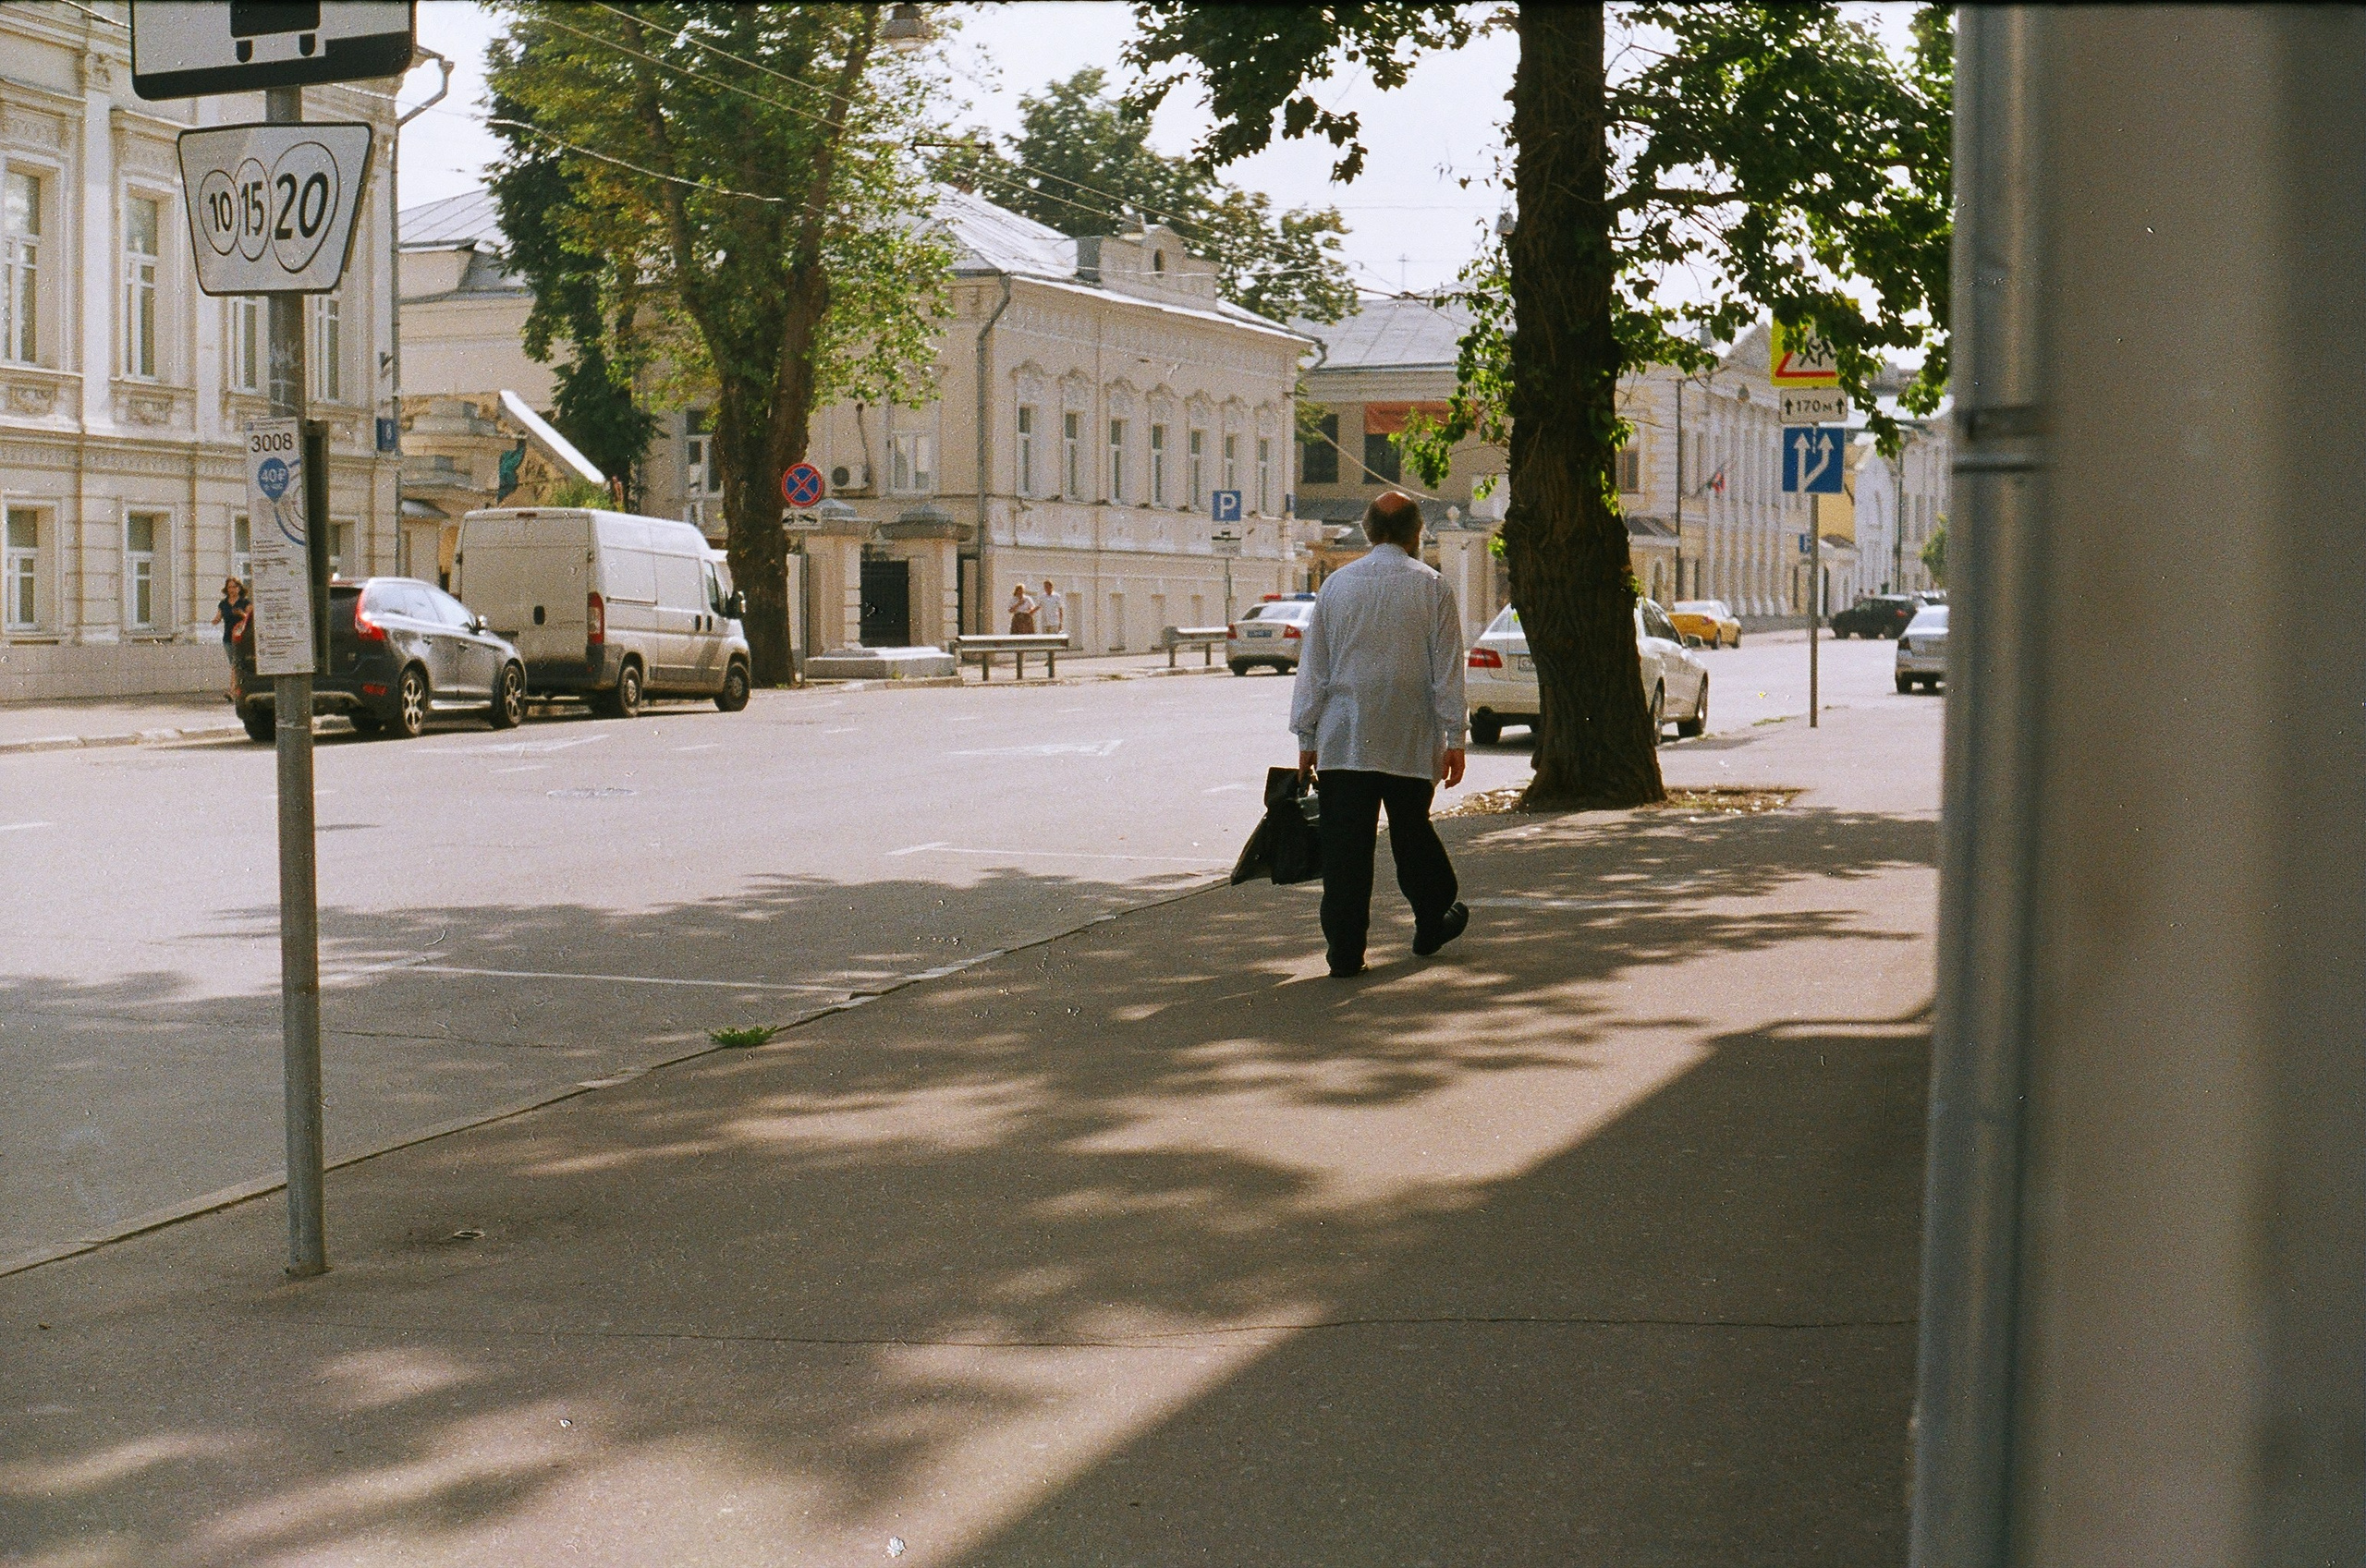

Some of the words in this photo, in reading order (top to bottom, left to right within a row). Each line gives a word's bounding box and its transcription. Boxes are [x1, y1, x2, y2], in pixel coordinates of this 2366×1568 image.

[209, 190, 233, 232] 10
[241, 181, 264, 237] 15
[274, 171, 329, 240] 20
[250, 432, 293, 453] 3008
[1220, 492, 1237, 518] P
